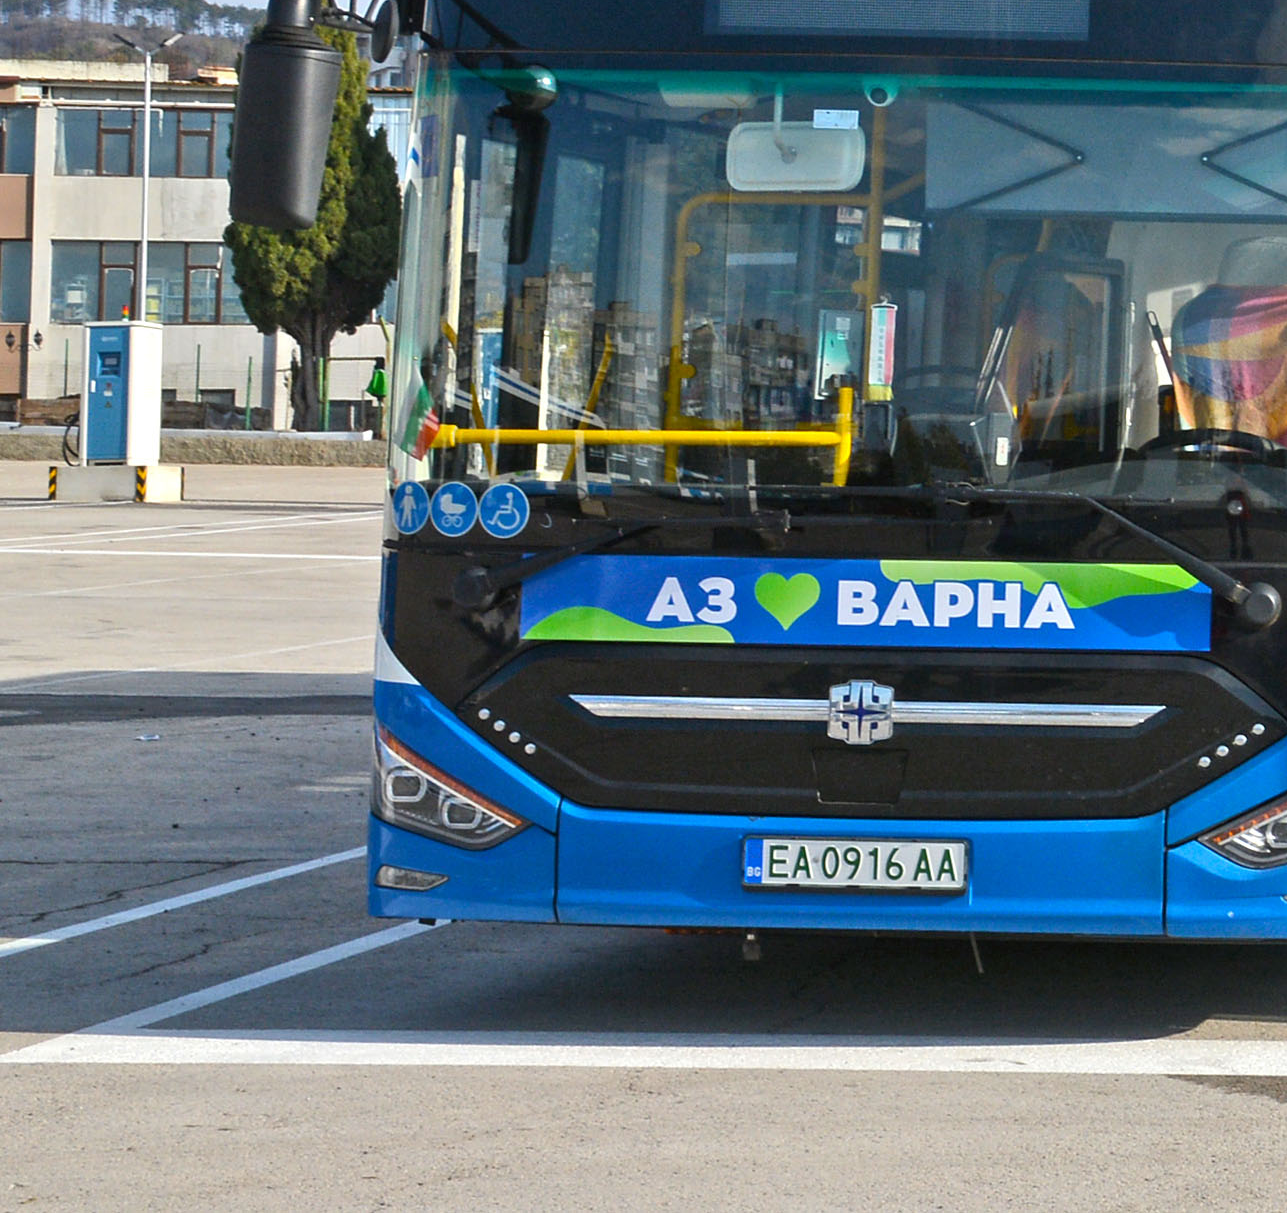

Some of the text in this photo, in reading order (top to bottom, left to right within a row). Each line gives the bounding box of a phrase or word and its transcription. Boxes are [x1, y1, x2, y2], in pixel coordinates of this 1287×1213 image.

[646, 576, 1075, 629] АЗ ВАРНА
[746, 866, 761, 878] BG
